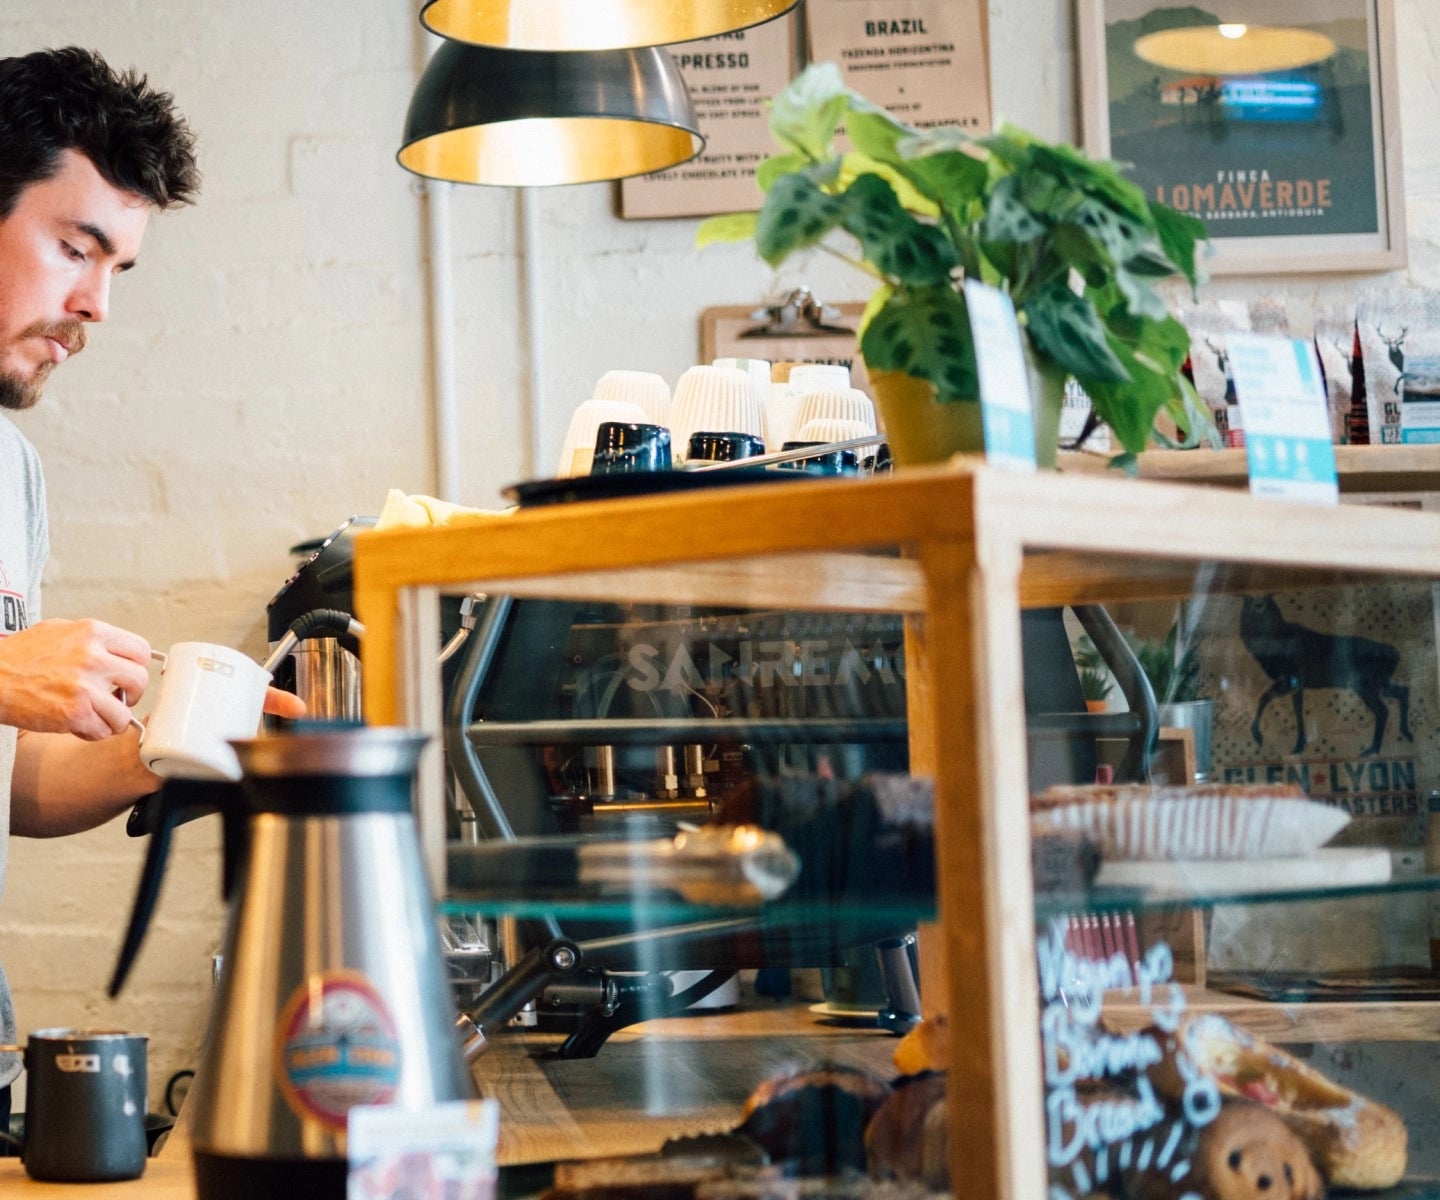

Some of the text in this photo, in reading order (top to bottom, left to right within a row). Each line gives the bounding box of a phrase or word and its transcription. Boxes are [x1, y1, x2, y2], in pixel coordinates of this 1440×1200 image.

[865, 19, 928, 37] BRAZIL
[672, 53, 749, 70] PRESSO
[1216, 169, 1270, 185] FINCA
[1329, 762, 1416, 793] LYON
